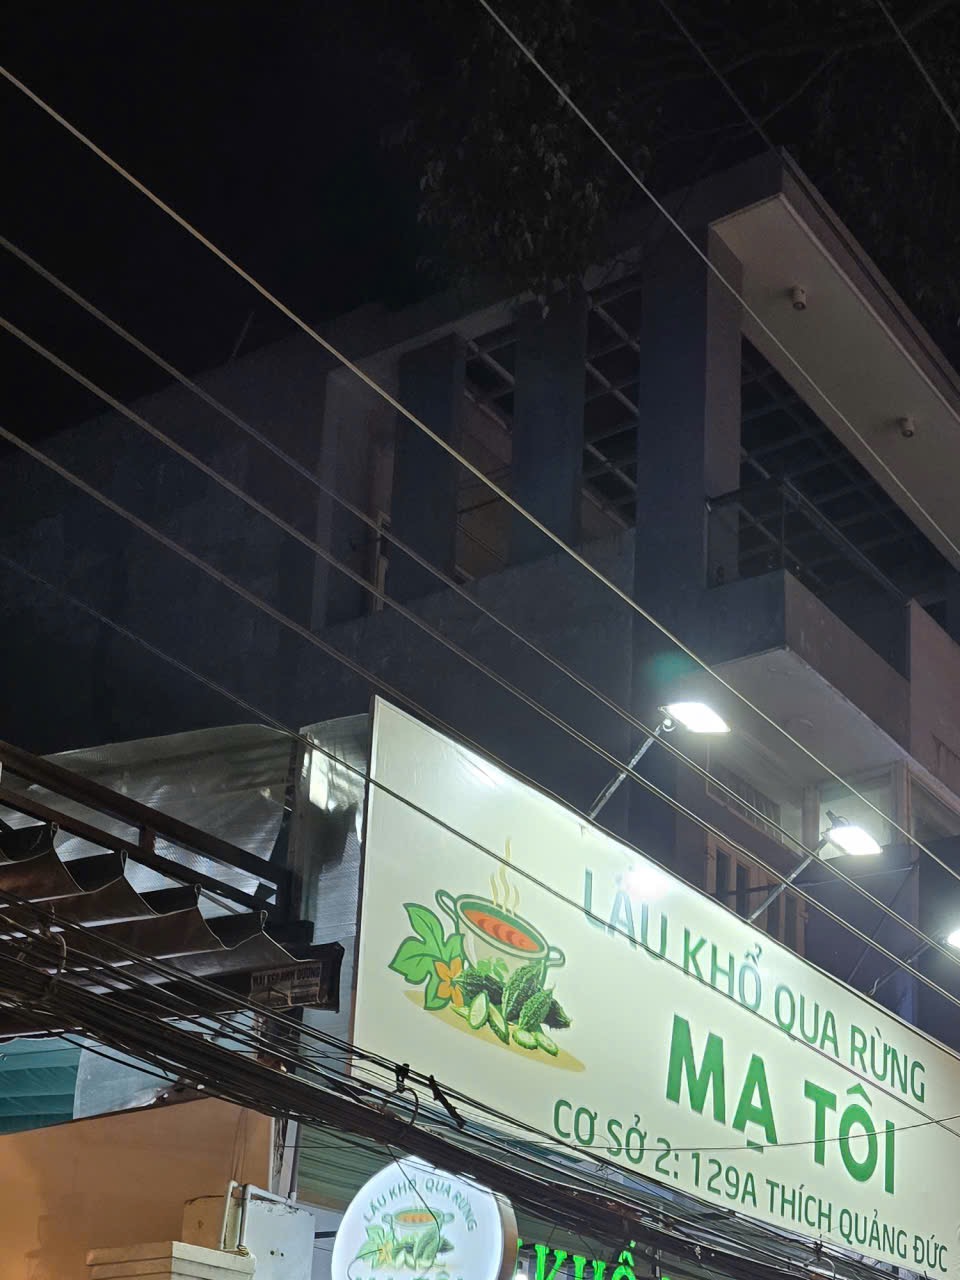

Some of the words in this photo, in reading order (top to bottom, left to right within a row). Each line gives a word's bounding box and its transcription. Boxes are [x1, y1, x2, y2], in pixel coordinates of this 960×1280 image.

[683, 927, 762, 1013] KHỔ
[774, 984, 839, 1058] QUA
[851, 1024, 925, 1103] RỪNG
[425, 1178, 450, 1198] QUA
[554, 1099, 597, 1146] CƠ
[606, 1114, 647, 1164] SỞ
[655, 1138, 679, 1179] 2:
[692, 1152, 757, 1208] 129A
[766, 1178, 832, 1232] THÍCH
[839, 1208, 907, 1259] QUẢNG
[912, 1234, 948, 1272] ĐỨC
[666, 1012, 778, 1154] MẠ
[804, 1080, 894, 1195] TÔI
